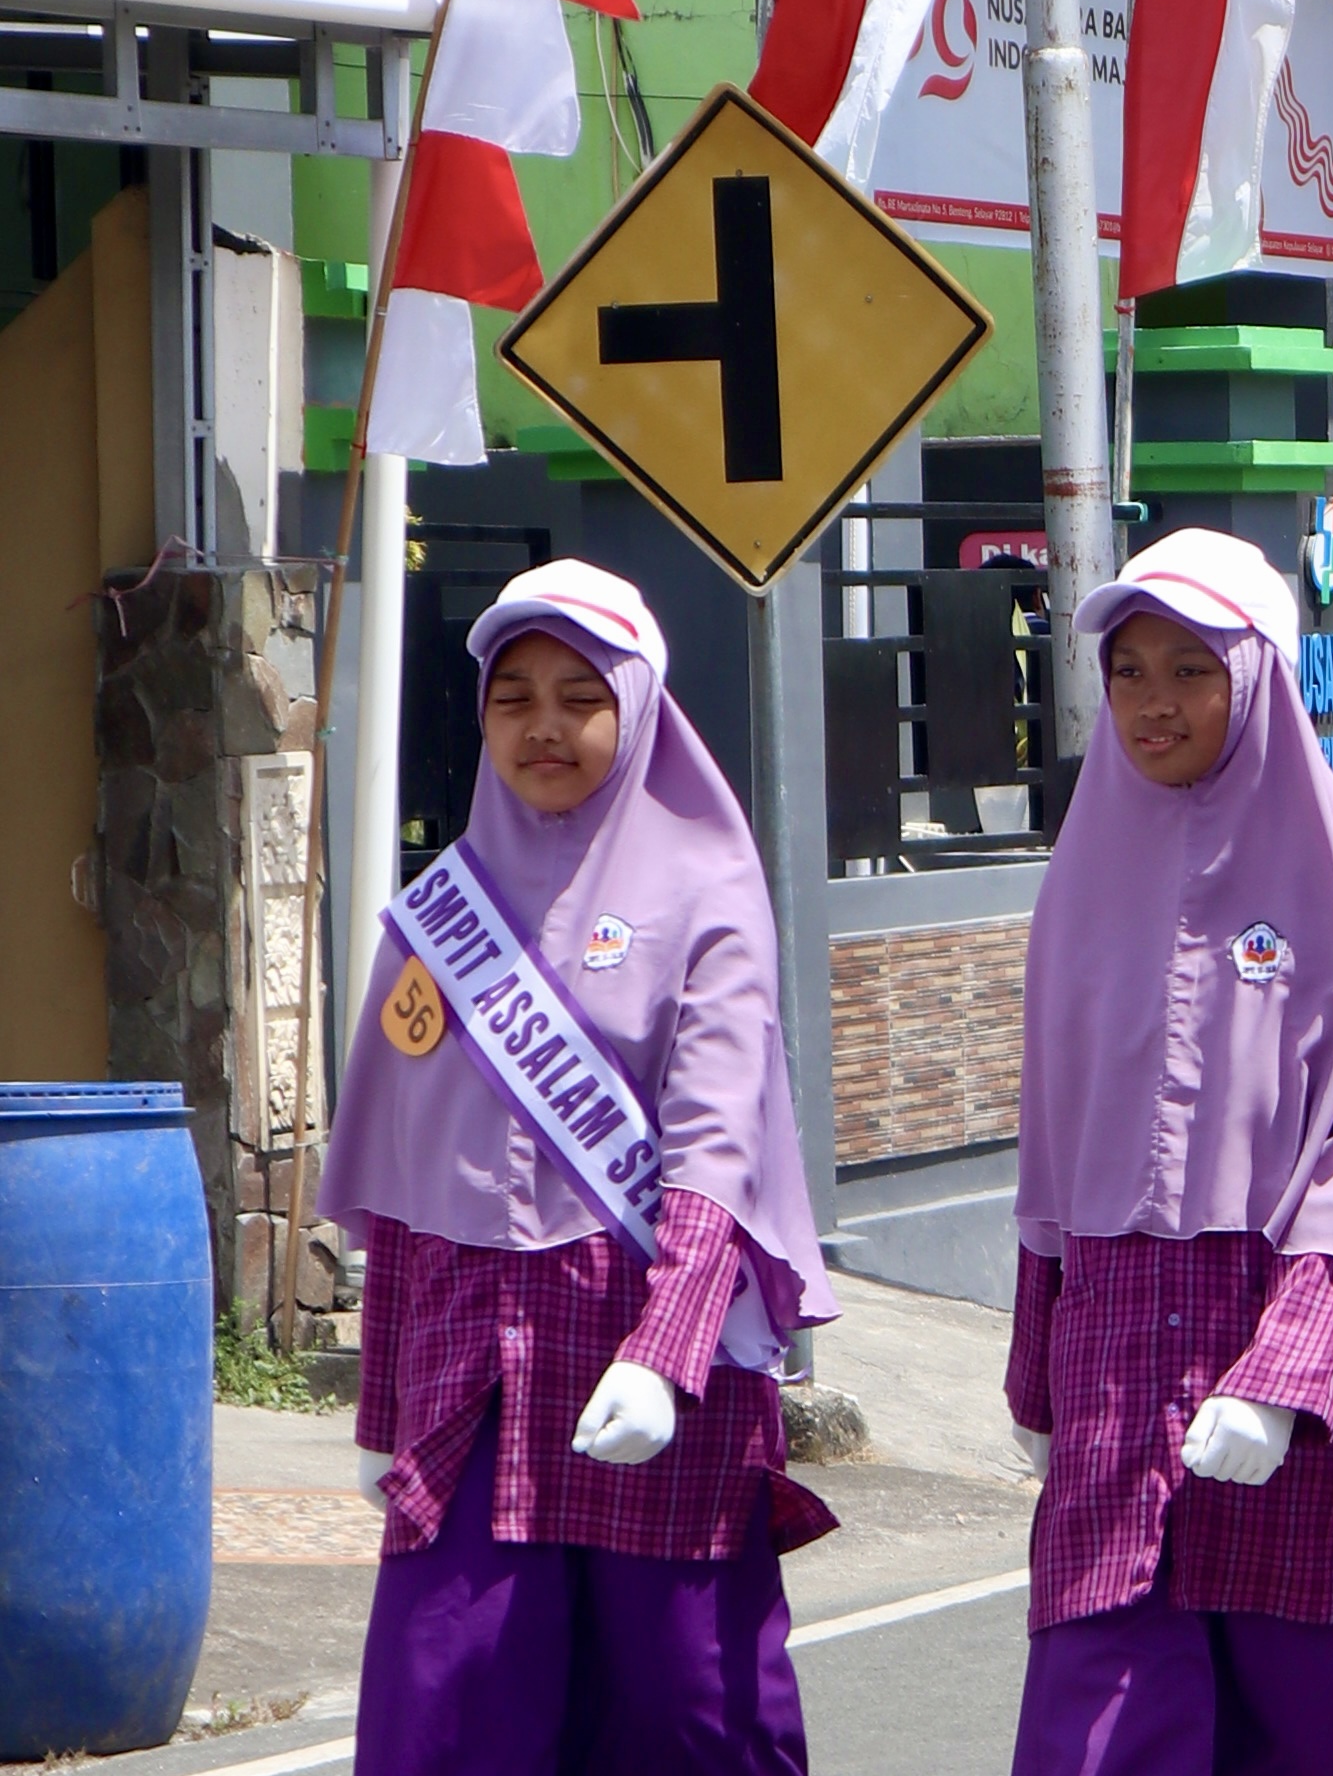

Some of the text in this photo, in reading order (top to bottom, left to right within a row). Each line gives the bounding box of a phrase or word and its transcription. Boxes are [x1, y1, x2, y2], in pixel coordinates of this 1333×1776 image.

[1102, 9, 1127, 40] BA
[394, 978, 435, 1044] 56
[405, 867, 502, 982] SMPIT
[470, 971, 628, 1152] ASSALAM
